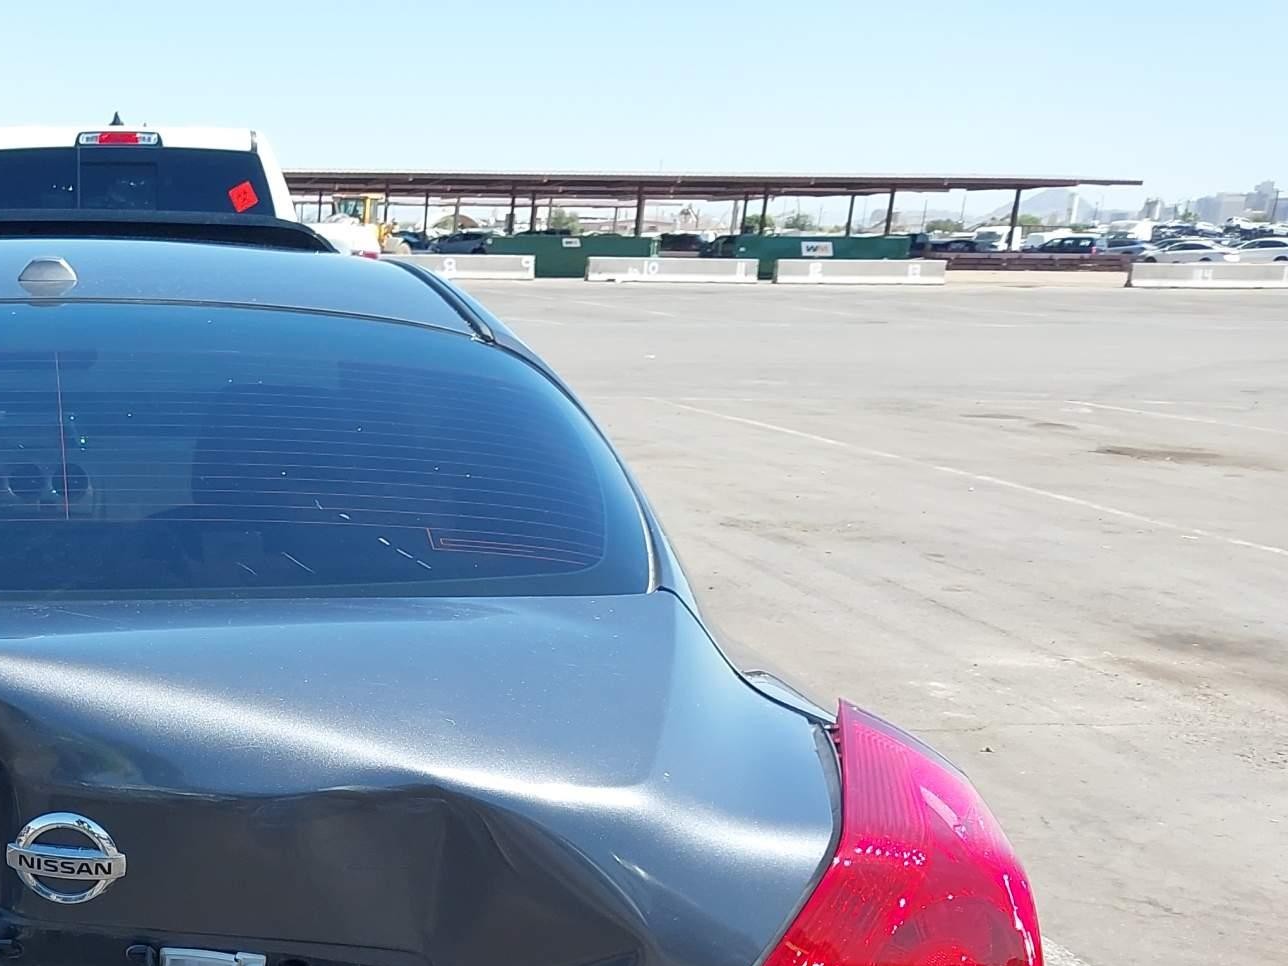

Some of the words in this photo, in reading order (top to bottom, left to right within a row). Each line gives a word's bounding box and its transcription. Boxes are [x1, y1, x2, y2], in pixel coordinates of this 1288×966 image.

[443, 258, 457, 273] 8
[643, 260, 660, 275] 10
[17, 852, 114, 877] NISSAN
